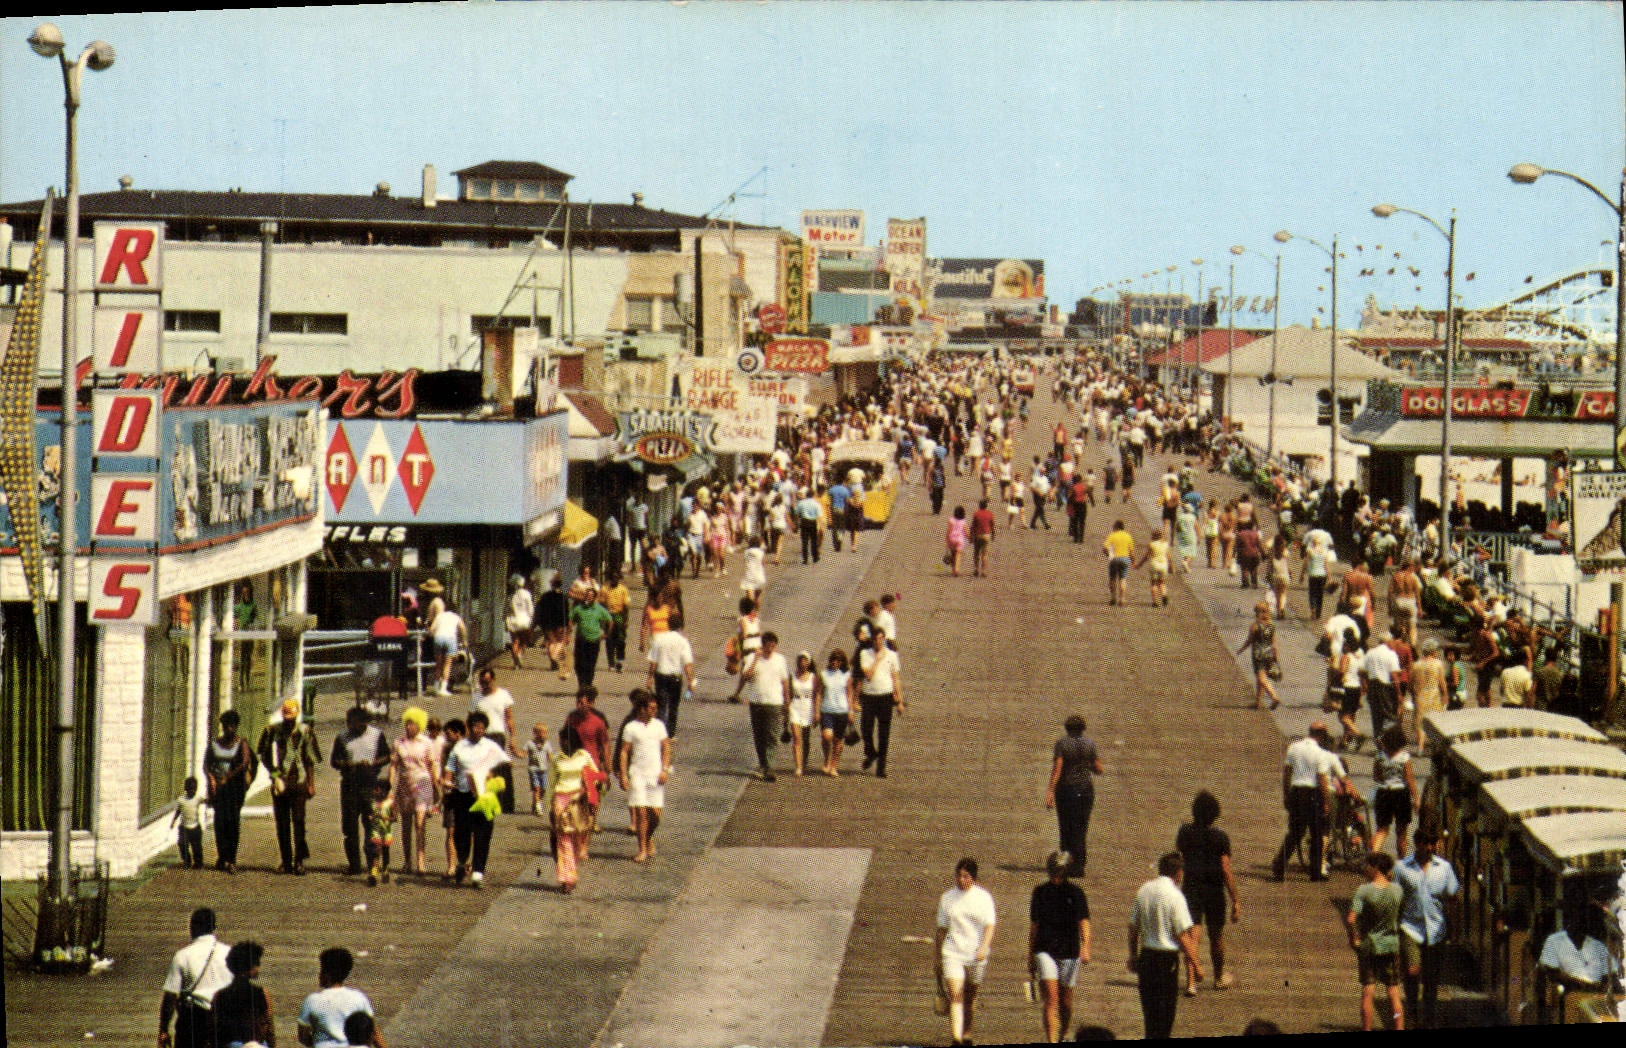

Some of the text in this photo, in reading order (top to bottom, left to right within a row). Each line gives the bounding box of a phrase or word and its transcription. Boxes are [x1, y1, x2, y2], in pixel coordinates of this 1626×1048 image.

[808, 228, 855, 242] Motor
[693, 368, 733, 388] RIFLE
[687, 389, 738, 410] RANGE
[1409, 396, 1522, 413] DOGLASS
[94, 228, 155, 620] RIDES
